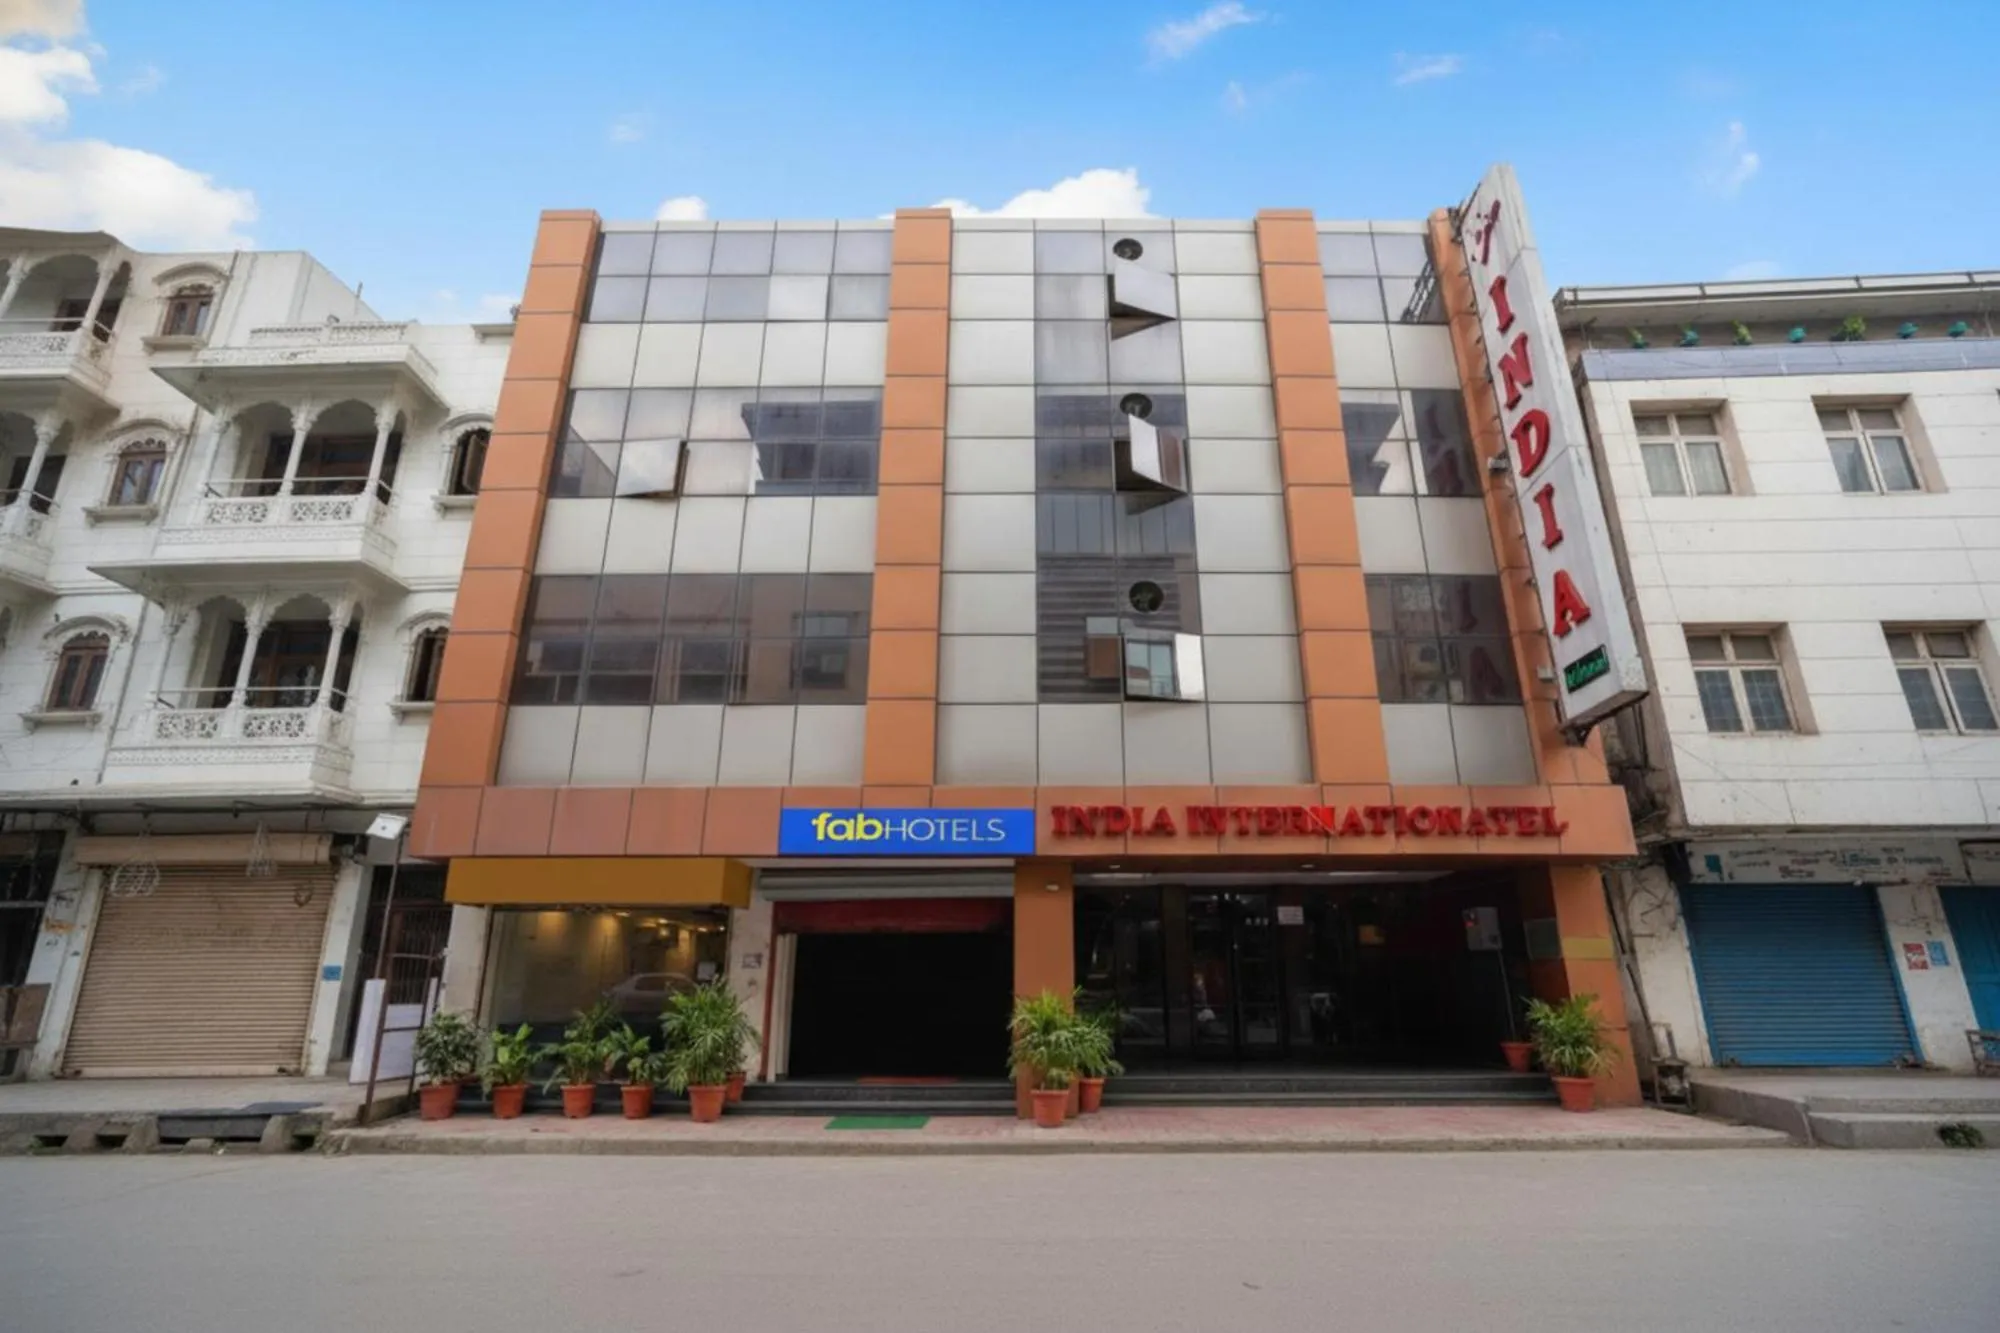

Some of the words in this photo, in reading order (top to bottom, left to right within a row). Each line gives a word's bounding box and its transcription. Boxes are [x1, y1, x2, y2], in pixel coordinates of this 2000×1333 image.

[1488, 274, 1592, 638] INDIA
[811, 812, 1006, 842] fabHOTELS
[1051, 805, 1177, 838] INDIA
